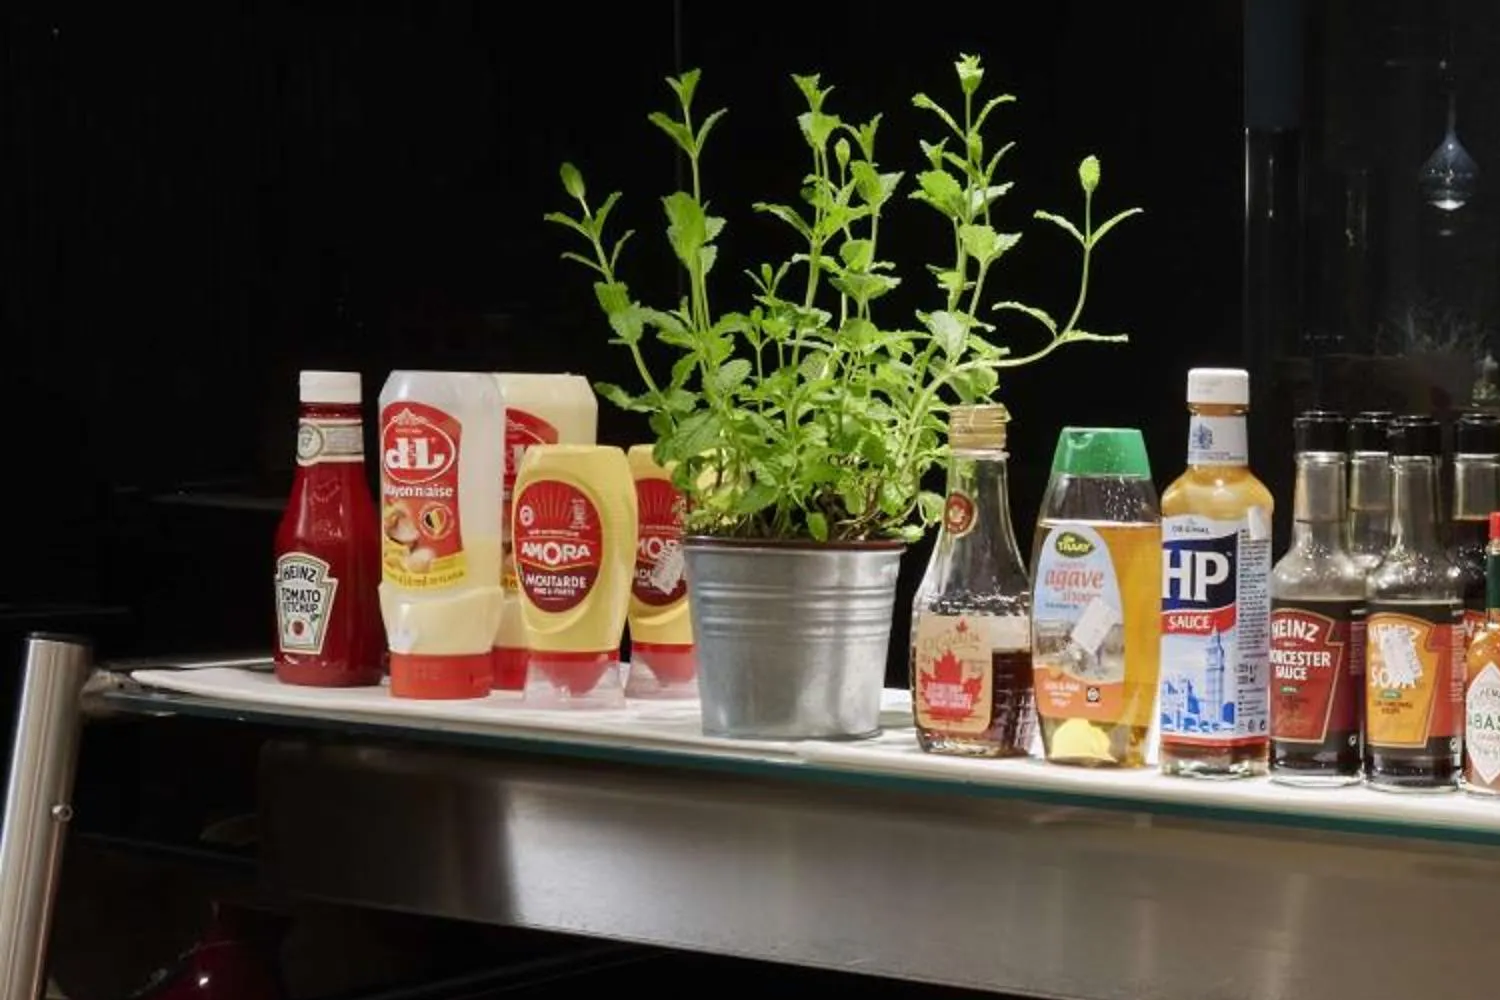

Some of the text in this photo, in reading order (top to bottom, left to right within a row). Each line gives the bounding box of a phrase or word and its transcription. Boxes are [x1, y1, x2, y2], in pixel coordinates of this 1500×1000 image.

[521, 541, 591, 566] AMORA
[284, 565, 318, 583] HEINZ
[525, 573, 587, 589] MOUTARDE
[1044, 569, 1104, 592] agave
[1163, 549, 1230, 601] HP
[281, 587, 321, 602] TOMATO
[1168, 615, 1211, 630] SAUCE
[1271, 618, 1320, 643] HEINZ
[1275, 665, 1308, 681] SAUCE
